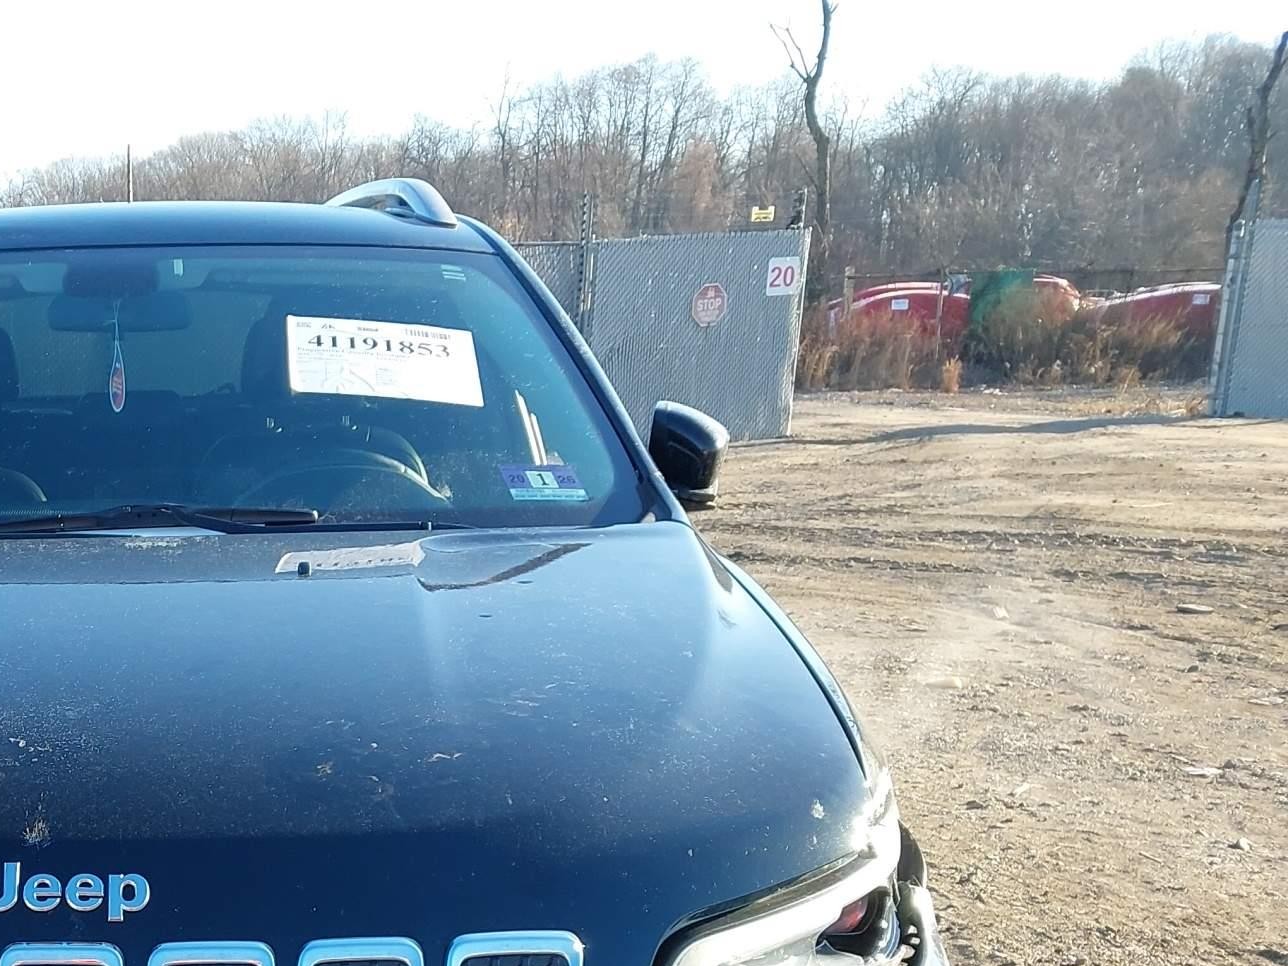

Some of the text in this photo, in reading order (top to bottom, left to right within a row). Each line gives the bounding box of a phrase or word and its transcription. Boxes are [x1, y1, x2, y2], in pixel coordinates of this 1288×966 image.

[769, 266, 795, 288] 20
[696, 298, 722, 311] STOP
[307, 334, 450, 358] 41191853
[536, 473, 549, 486] 1
